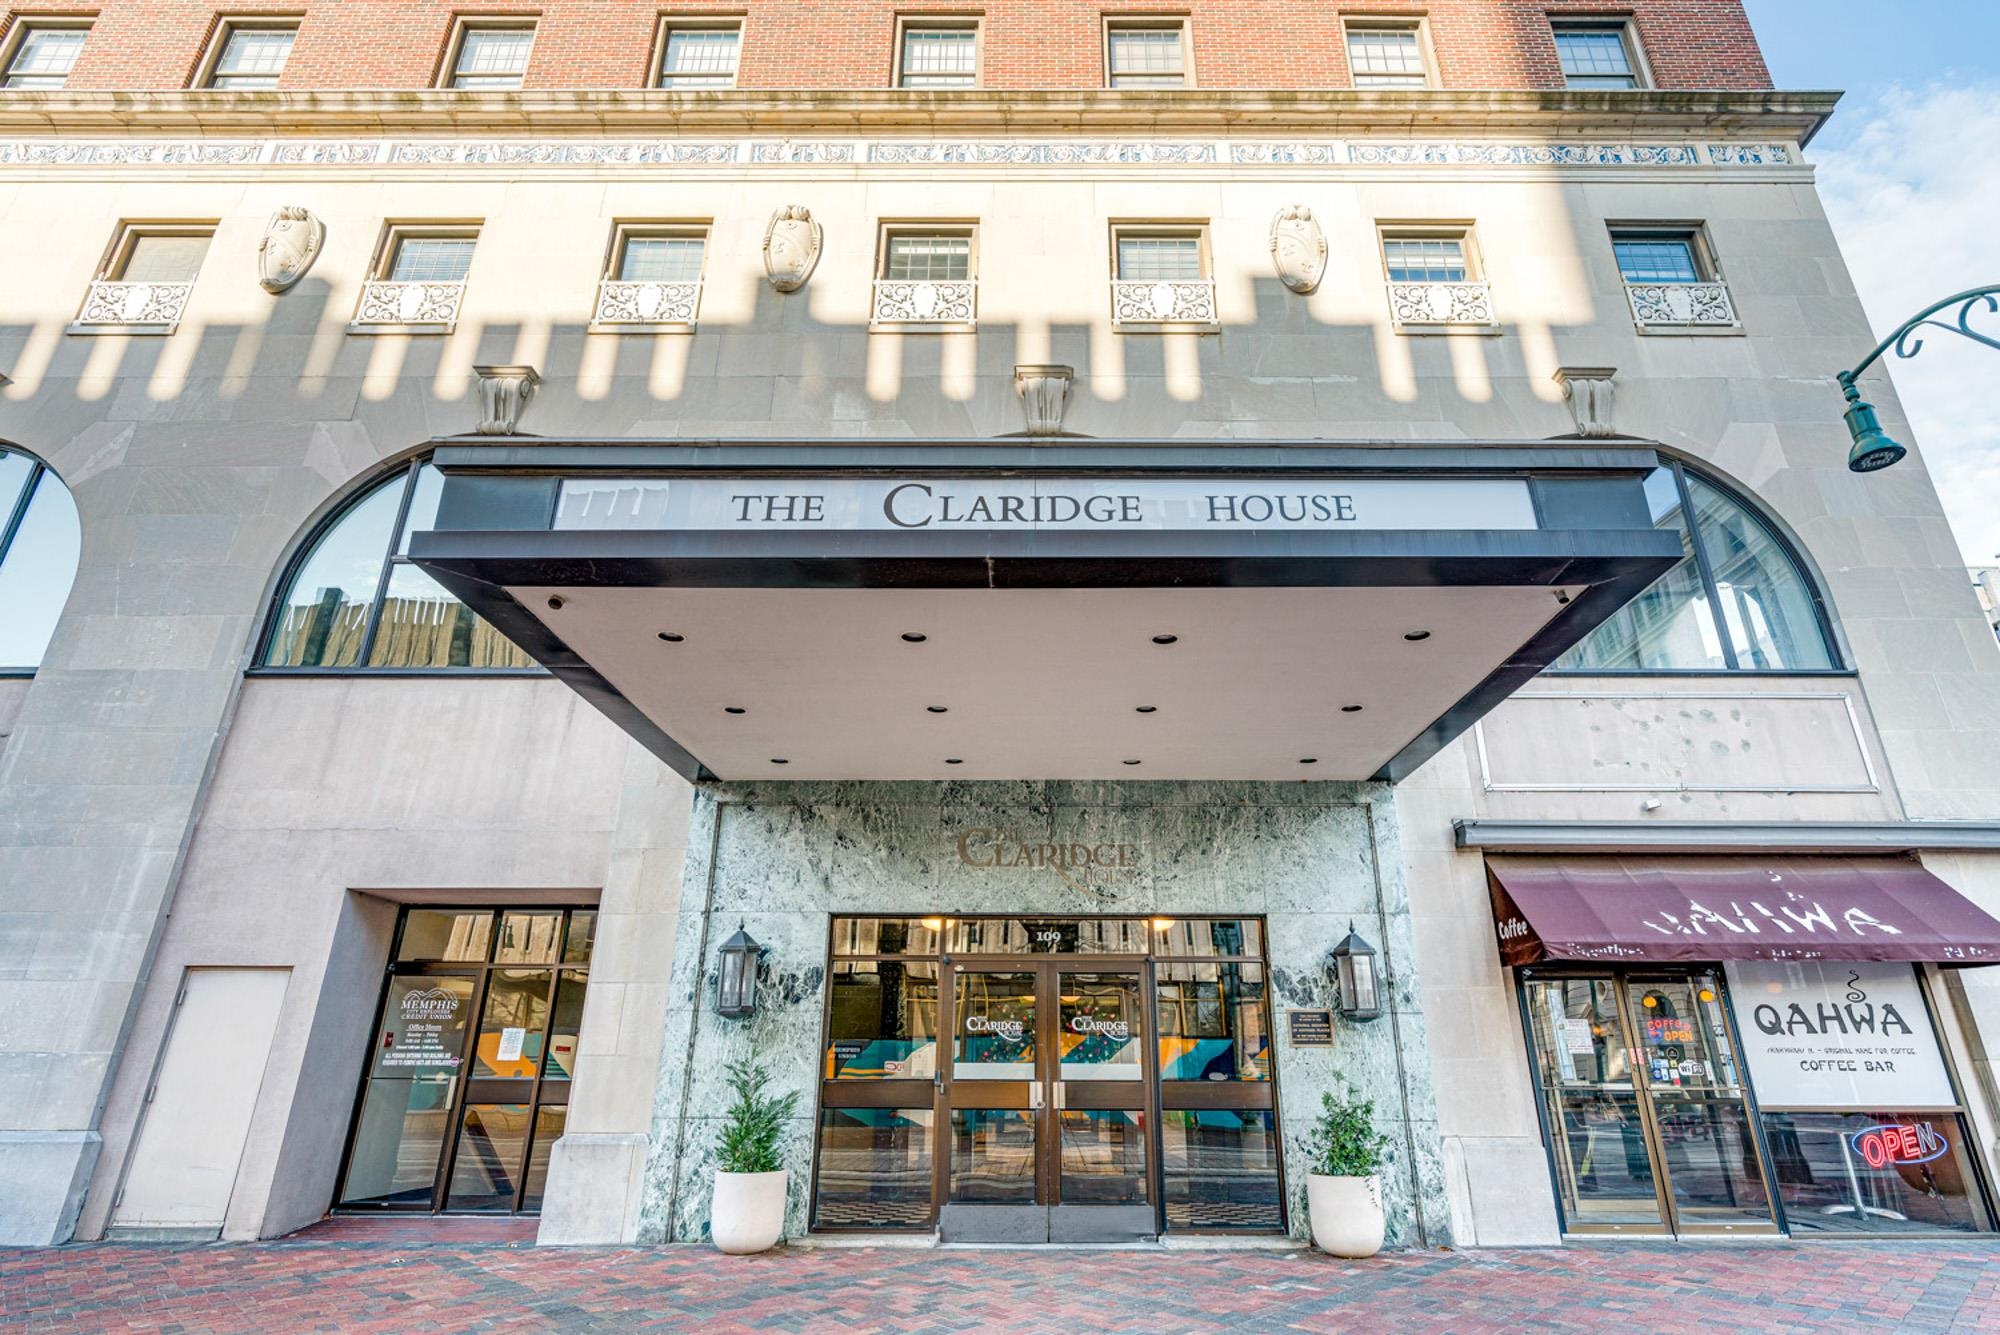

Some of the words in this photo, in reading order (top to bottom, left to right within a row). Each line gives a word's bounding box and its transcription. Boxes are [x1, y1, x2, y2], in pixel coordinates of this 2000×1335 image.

[732, 495, 825, 522] THE
[883, 484, 1143, 529] CLARIDGE
[1207, 495, 1357, 522] HOUSE
[957, 828, 1137, 873] CLARIDGE
[1036, 930, 1062, 943] 109
[1498, 917, 1529, 941] Coffee
[400, 1000, 458, 1011] MEMPHIS
[966, 1016, 1023, 1033] CLARIDGE
[1072, 1017, 1129, 1033] CLARIDGE
[1754, 1003, 1913, 1037] QAHWA
[1664, 1031, 1693, 1042] OPEN
[1800, 1060, 1857, 1072] COFFEE
[1864, 1060, 1897, 1073] BAR
[1863, 1121, 1937, 1168] OPEN
